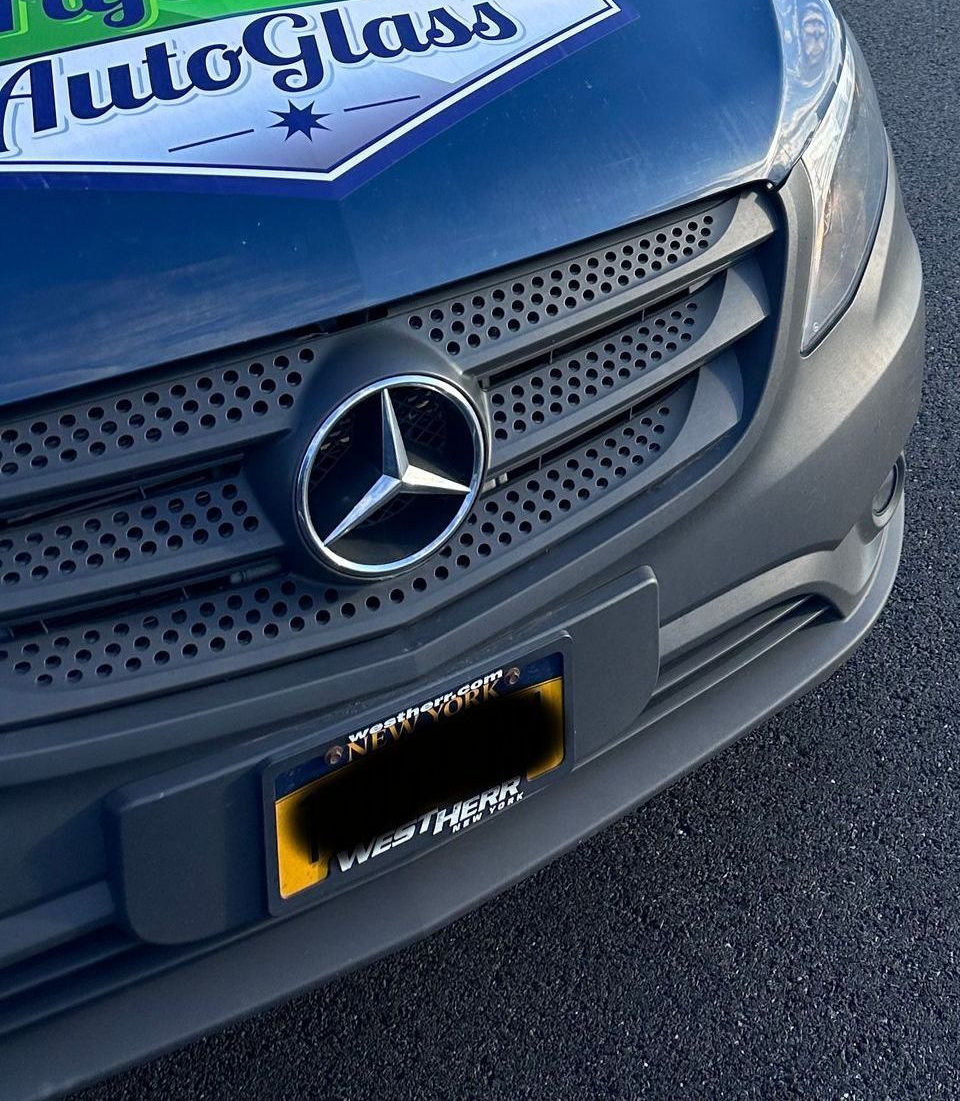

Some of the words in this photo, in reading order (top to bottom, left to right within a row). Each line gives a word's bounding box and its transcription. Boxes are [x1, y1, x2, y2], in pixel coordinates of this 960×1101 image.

[0, 1, 519, 152] AutoGlass
[347, 712, 421, 762] NEW
[426, 678, 502, 723] YORK
[348, 668, 504, 743] westherr.com
[452, 812, 483, 834] NEW
[489, 791, 524, 815] YORK
